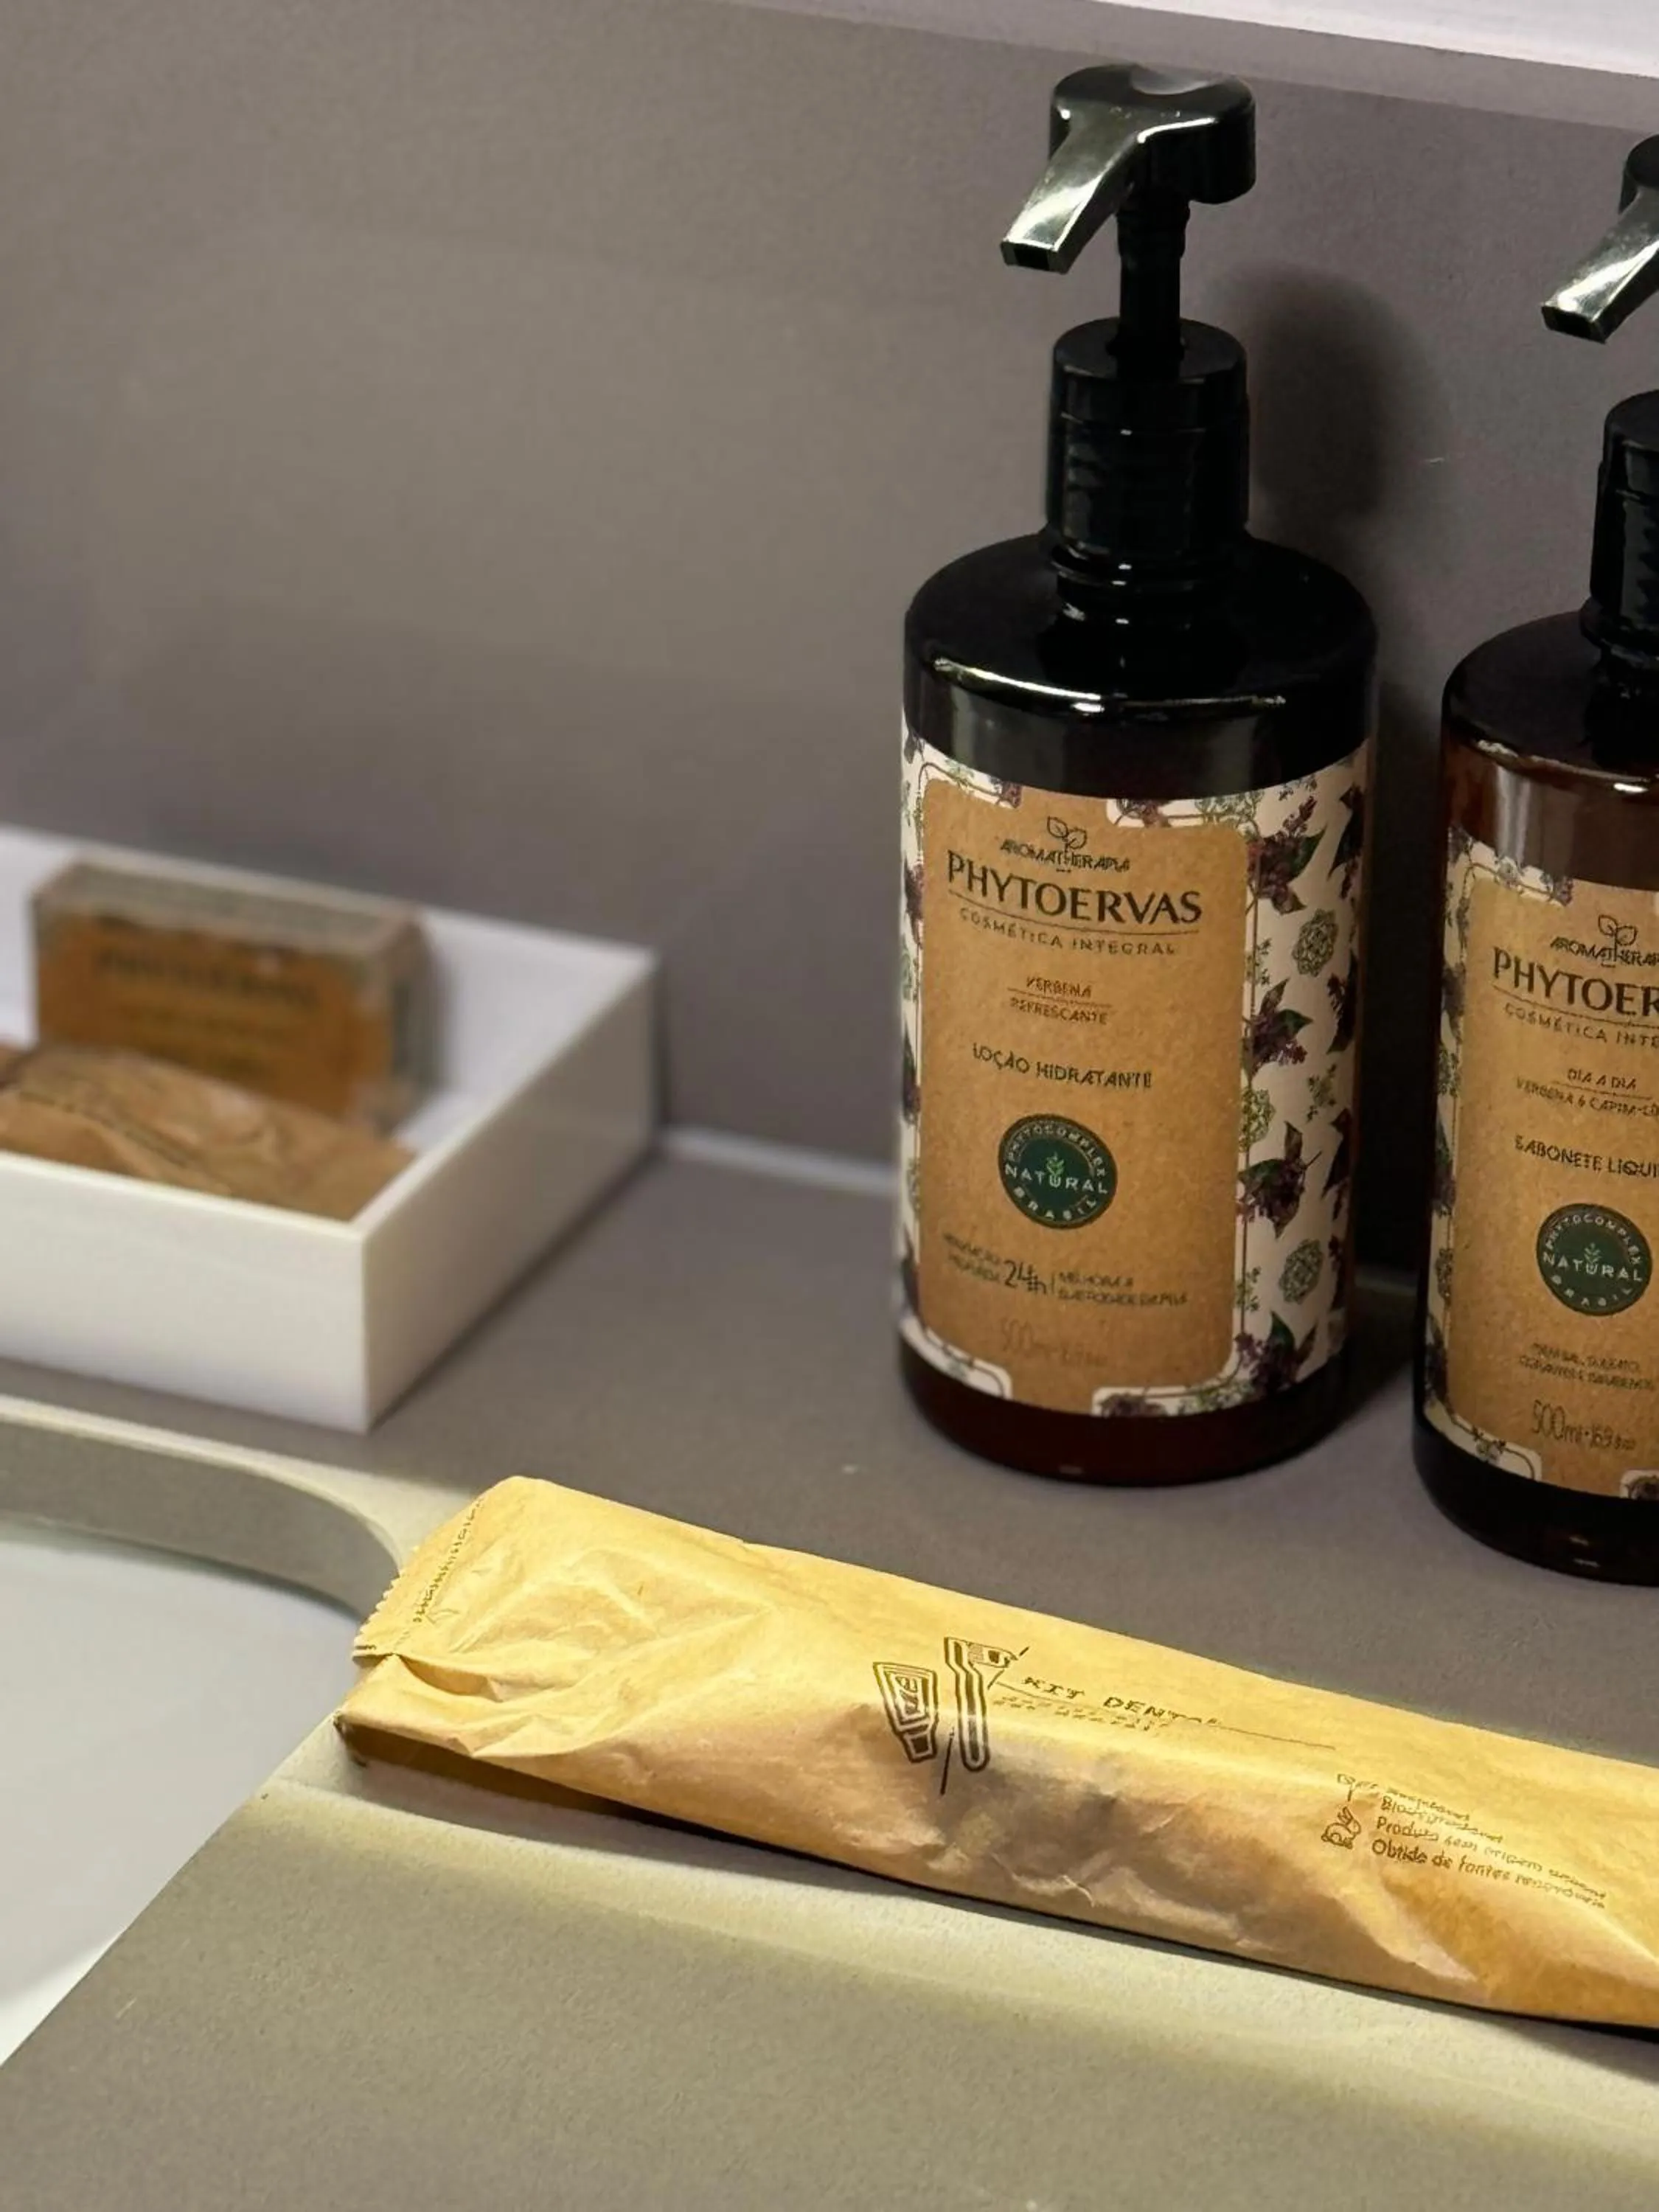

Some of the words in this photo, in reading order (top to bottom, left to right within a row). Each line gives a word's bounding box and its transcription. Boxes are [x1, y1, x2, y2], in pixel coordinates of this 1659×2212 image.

[947, 850, 1203, 925] PHYTOERVAS
[960, 907, 1064, 950] COSMÉTICA
[1072, 937, 1176, 956] INTEGRAL
[1026, 976, 1092, 998] VERBENA
[1493, 946, 1659, 1018] PHYTOER
[1009, 997, 1107, 1025] REFRESCANTE
[1505, 1002, 1607, 1043] COSMÉTICA
[973, 1042, 1030, 1074] LOÇÃO
[1036, 1060, 1152, 1088] HIDRATANTE
[1568, 1068, 1593, 1083] DIA
[1596, 1074, 1607, 1086] A
[1611, 1076, 1637, 1090] DIA
[1515, 1135, 1602, 1172] SABONETE
[1005, 1164, 1107, 1194] NATURAL
[1014, 1186, 1096, 1220] BRASIL
[1543, 1253, 1642, 1282] NATURAL
[1552, 1275, 1632, 1307] BRASIL
[1022, 1676, 1085, 1699] KIT
[1432, 1851, 1453, 1869] de
[1458, 1854, 1510, 1881] fontes
